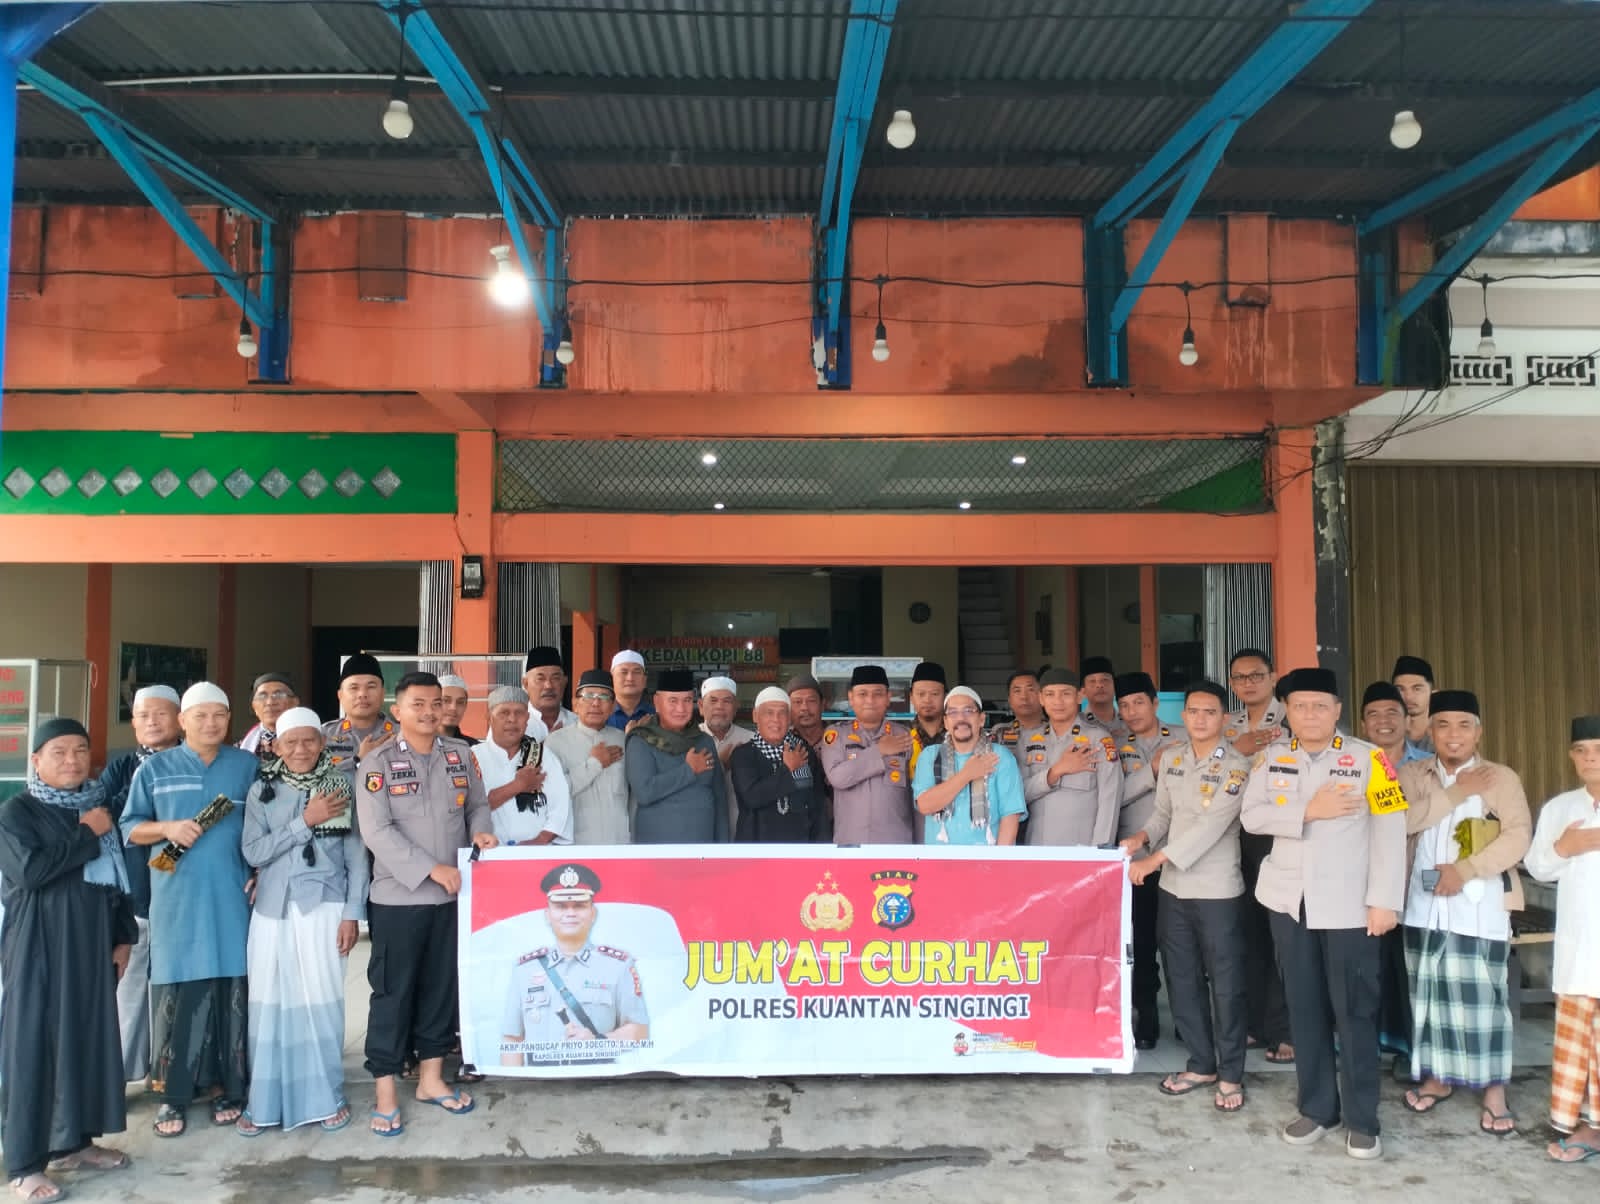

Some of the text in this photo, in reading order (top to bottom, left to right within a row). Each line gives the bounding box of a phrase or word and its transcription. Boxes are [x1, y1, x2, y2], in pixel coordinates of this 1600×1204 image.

[642, 648, 764, 662] KEDAI KOPI 88
[446, 764, 467, 774] POLRI
[1329, 769, 1361, 778] POLRI
[875, 871, 913, 880] RIAU
[683, 939, 1047, 990] JUM'AT CURHAT
[708, 995, 1029, 1019] POLRES KUANTAN SINGINGI
[500, 1042, 519, 1051] AKBP
[562, 1041, 582, 1049] PRIYO
